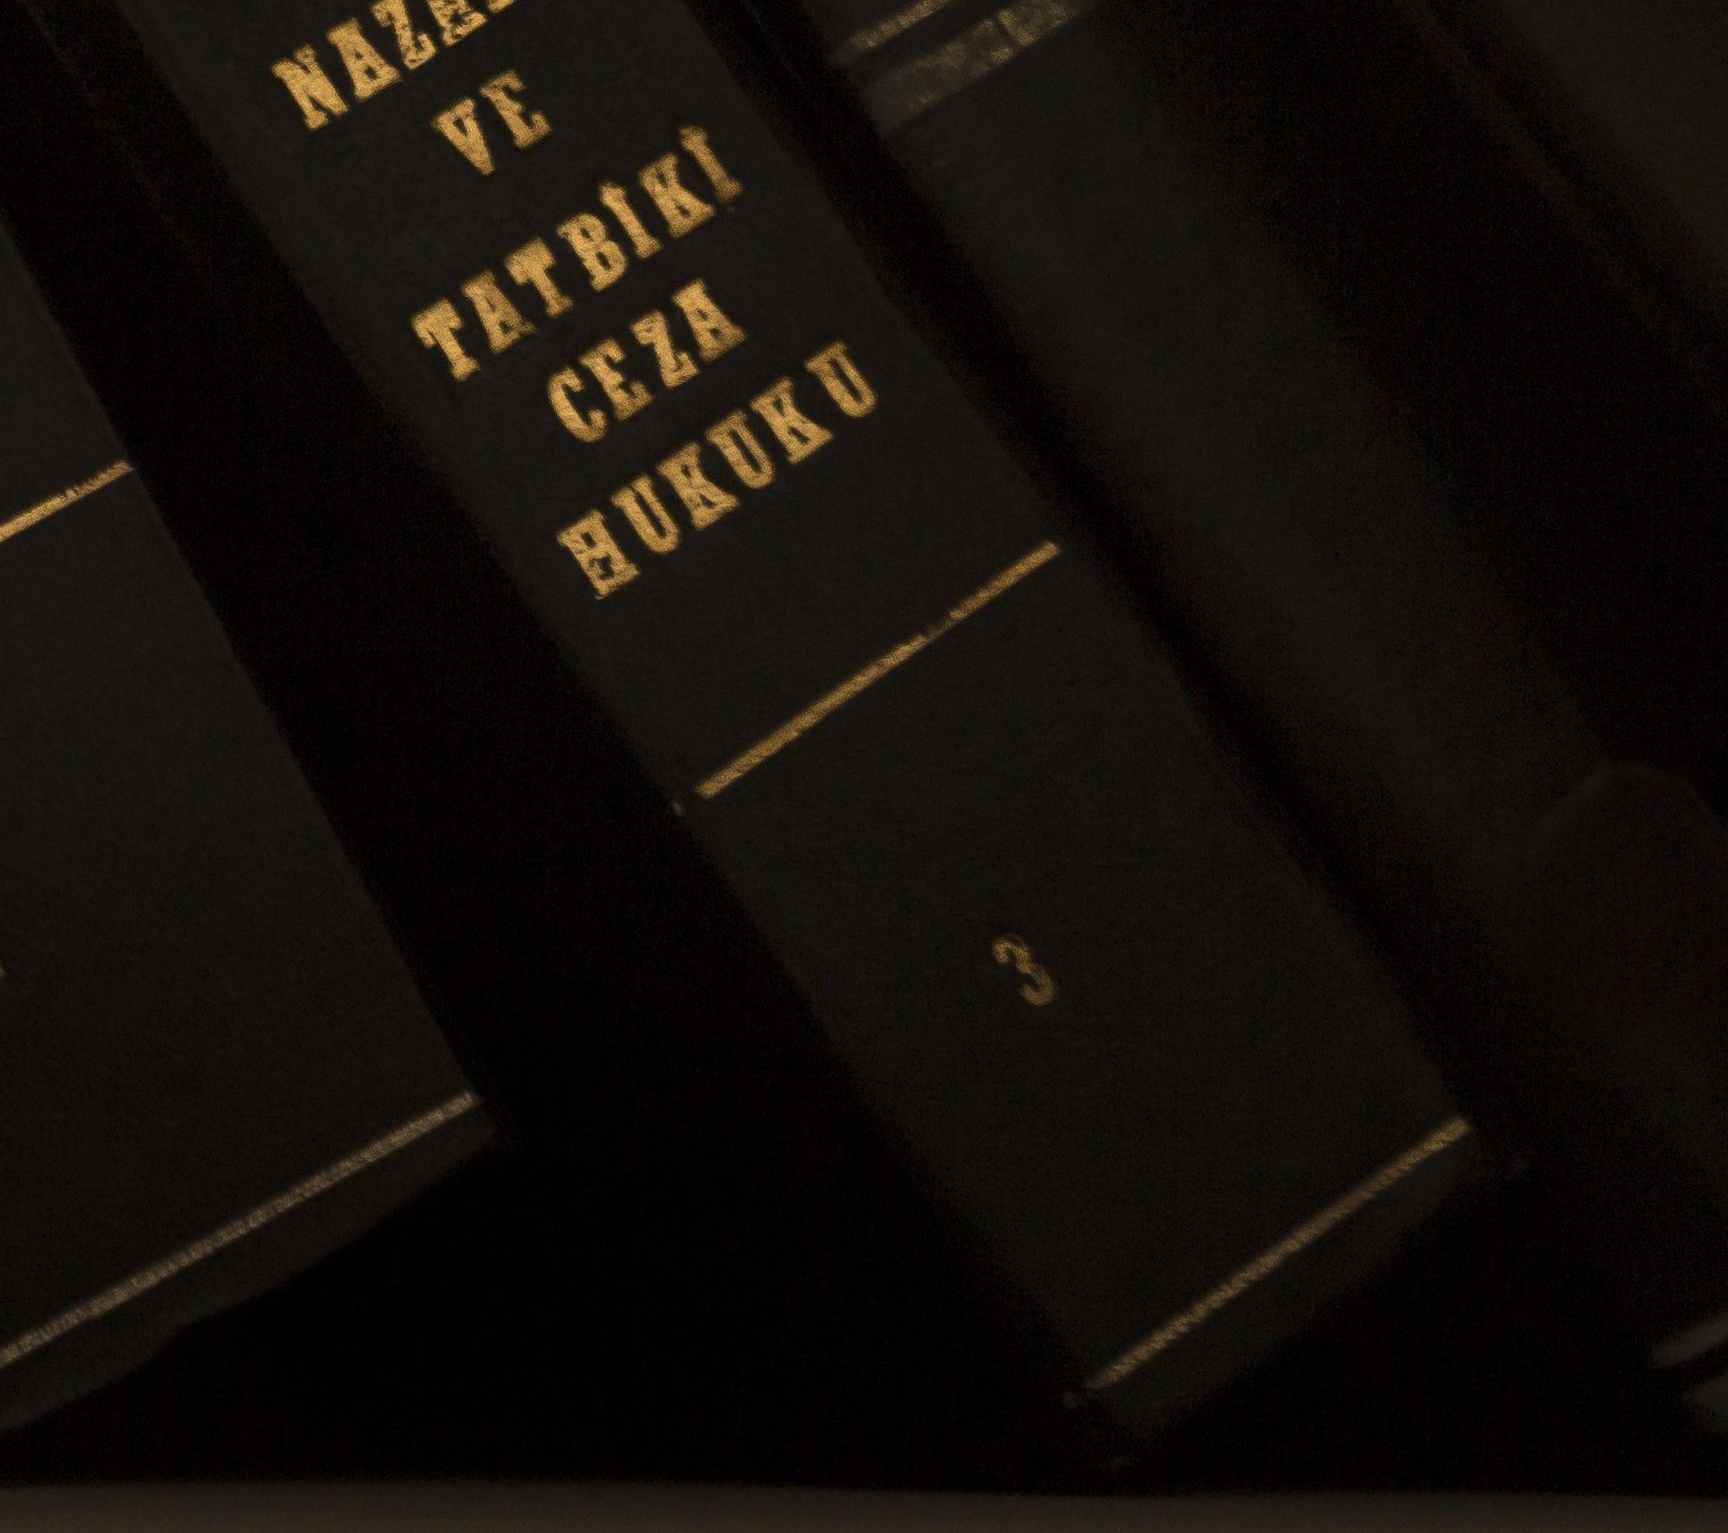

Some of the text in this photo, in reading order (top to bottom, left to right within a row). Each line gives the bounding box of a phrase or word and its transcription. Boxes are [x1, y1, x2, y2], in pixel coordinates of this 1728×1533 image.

[431, 69, 551, 175] VE
[547, 278, 746, 444] CEZA
[556, 340, 878, 600] HUKUKU
[993, 934, 1056, 1007] 3
